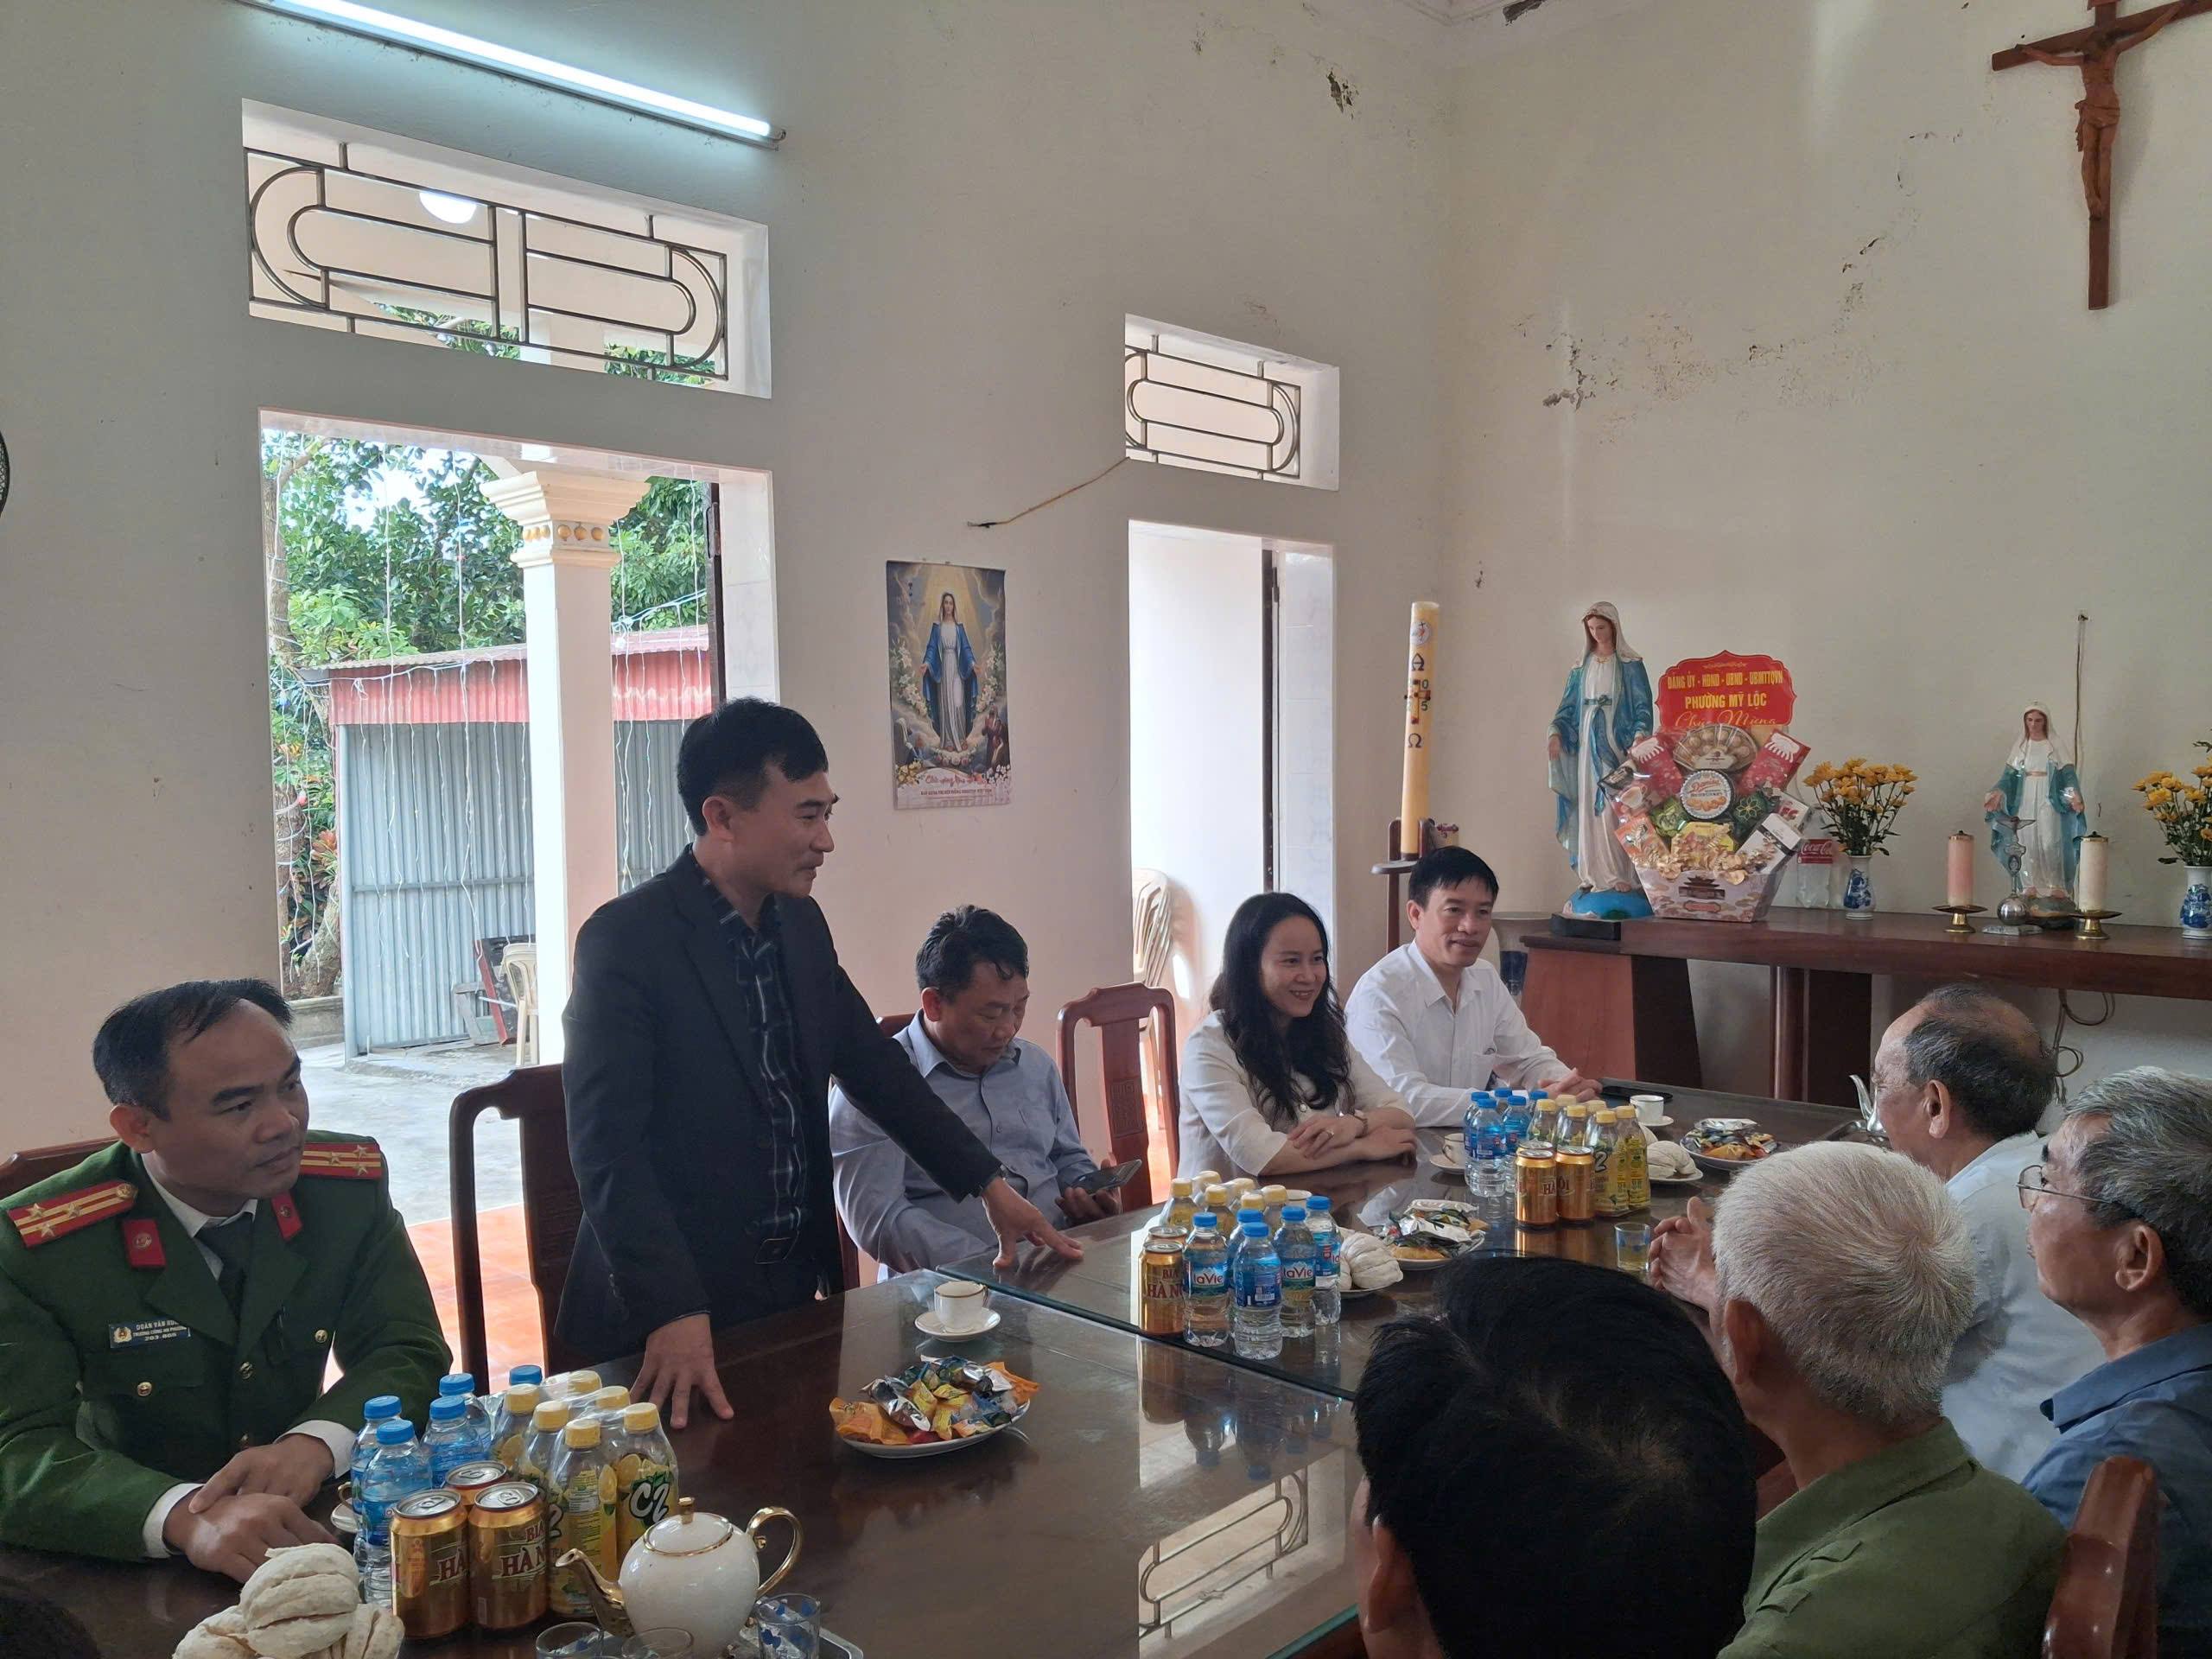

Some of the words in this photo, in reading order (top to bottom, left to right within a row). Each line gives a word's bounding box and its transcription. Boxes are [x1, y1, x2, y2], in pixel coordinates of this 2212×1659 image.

[1685, 692, 1726, 709] PHƯỜNG
[1728, 691, 1744, 708] MỸ
[1747, 690, 1767, 709] LỘC
[629, 1480, 671, 1524] C2
